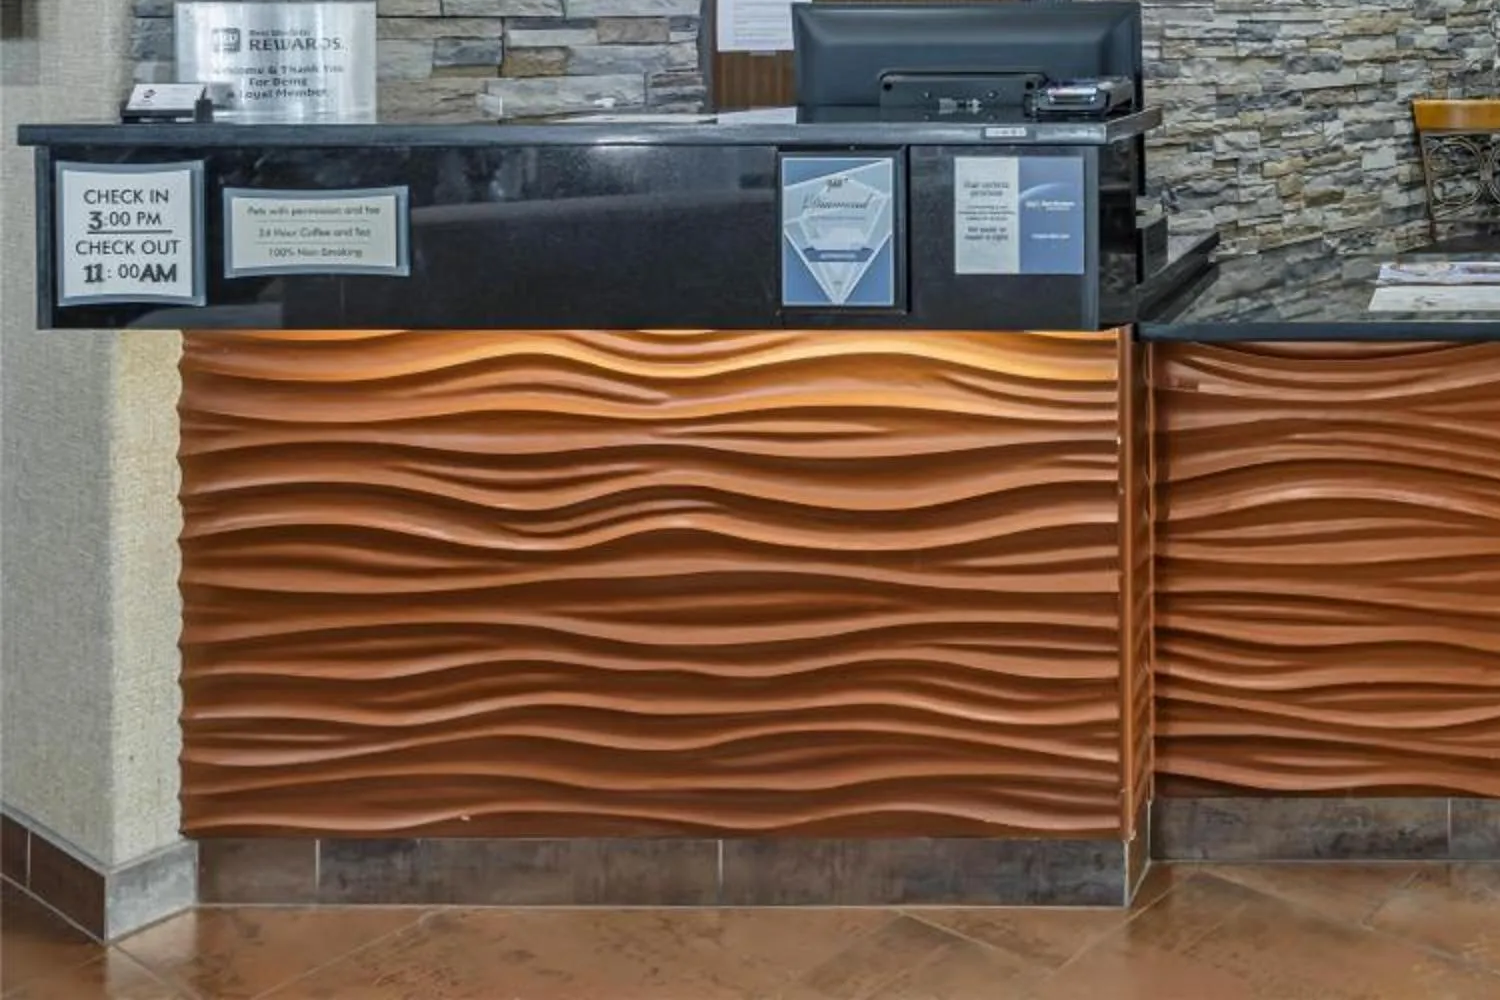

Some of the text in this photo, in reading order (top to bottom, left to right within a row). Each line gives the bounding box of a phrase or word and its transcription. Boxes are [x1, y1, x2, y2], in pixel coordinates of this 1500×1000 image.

[248, 37, 343, 52] REWARDS
[214, 64, 264, 75] lcome
[83, 188, 169, 205] CHECK IN
[291, 206, 341, 217] permission
[343, 204, 362, 215] and
[365, 204, 381, 215] fee
[87, 211, 162, 231] 3:00 PM
[299, 227, 331, 238] Coffee
[333, 227, 353, 238] and
[355, 227, 371, 238] Tea
[75, 239, 180, 256] CHECK OUT
[269, 247, 296, 258] 100%
